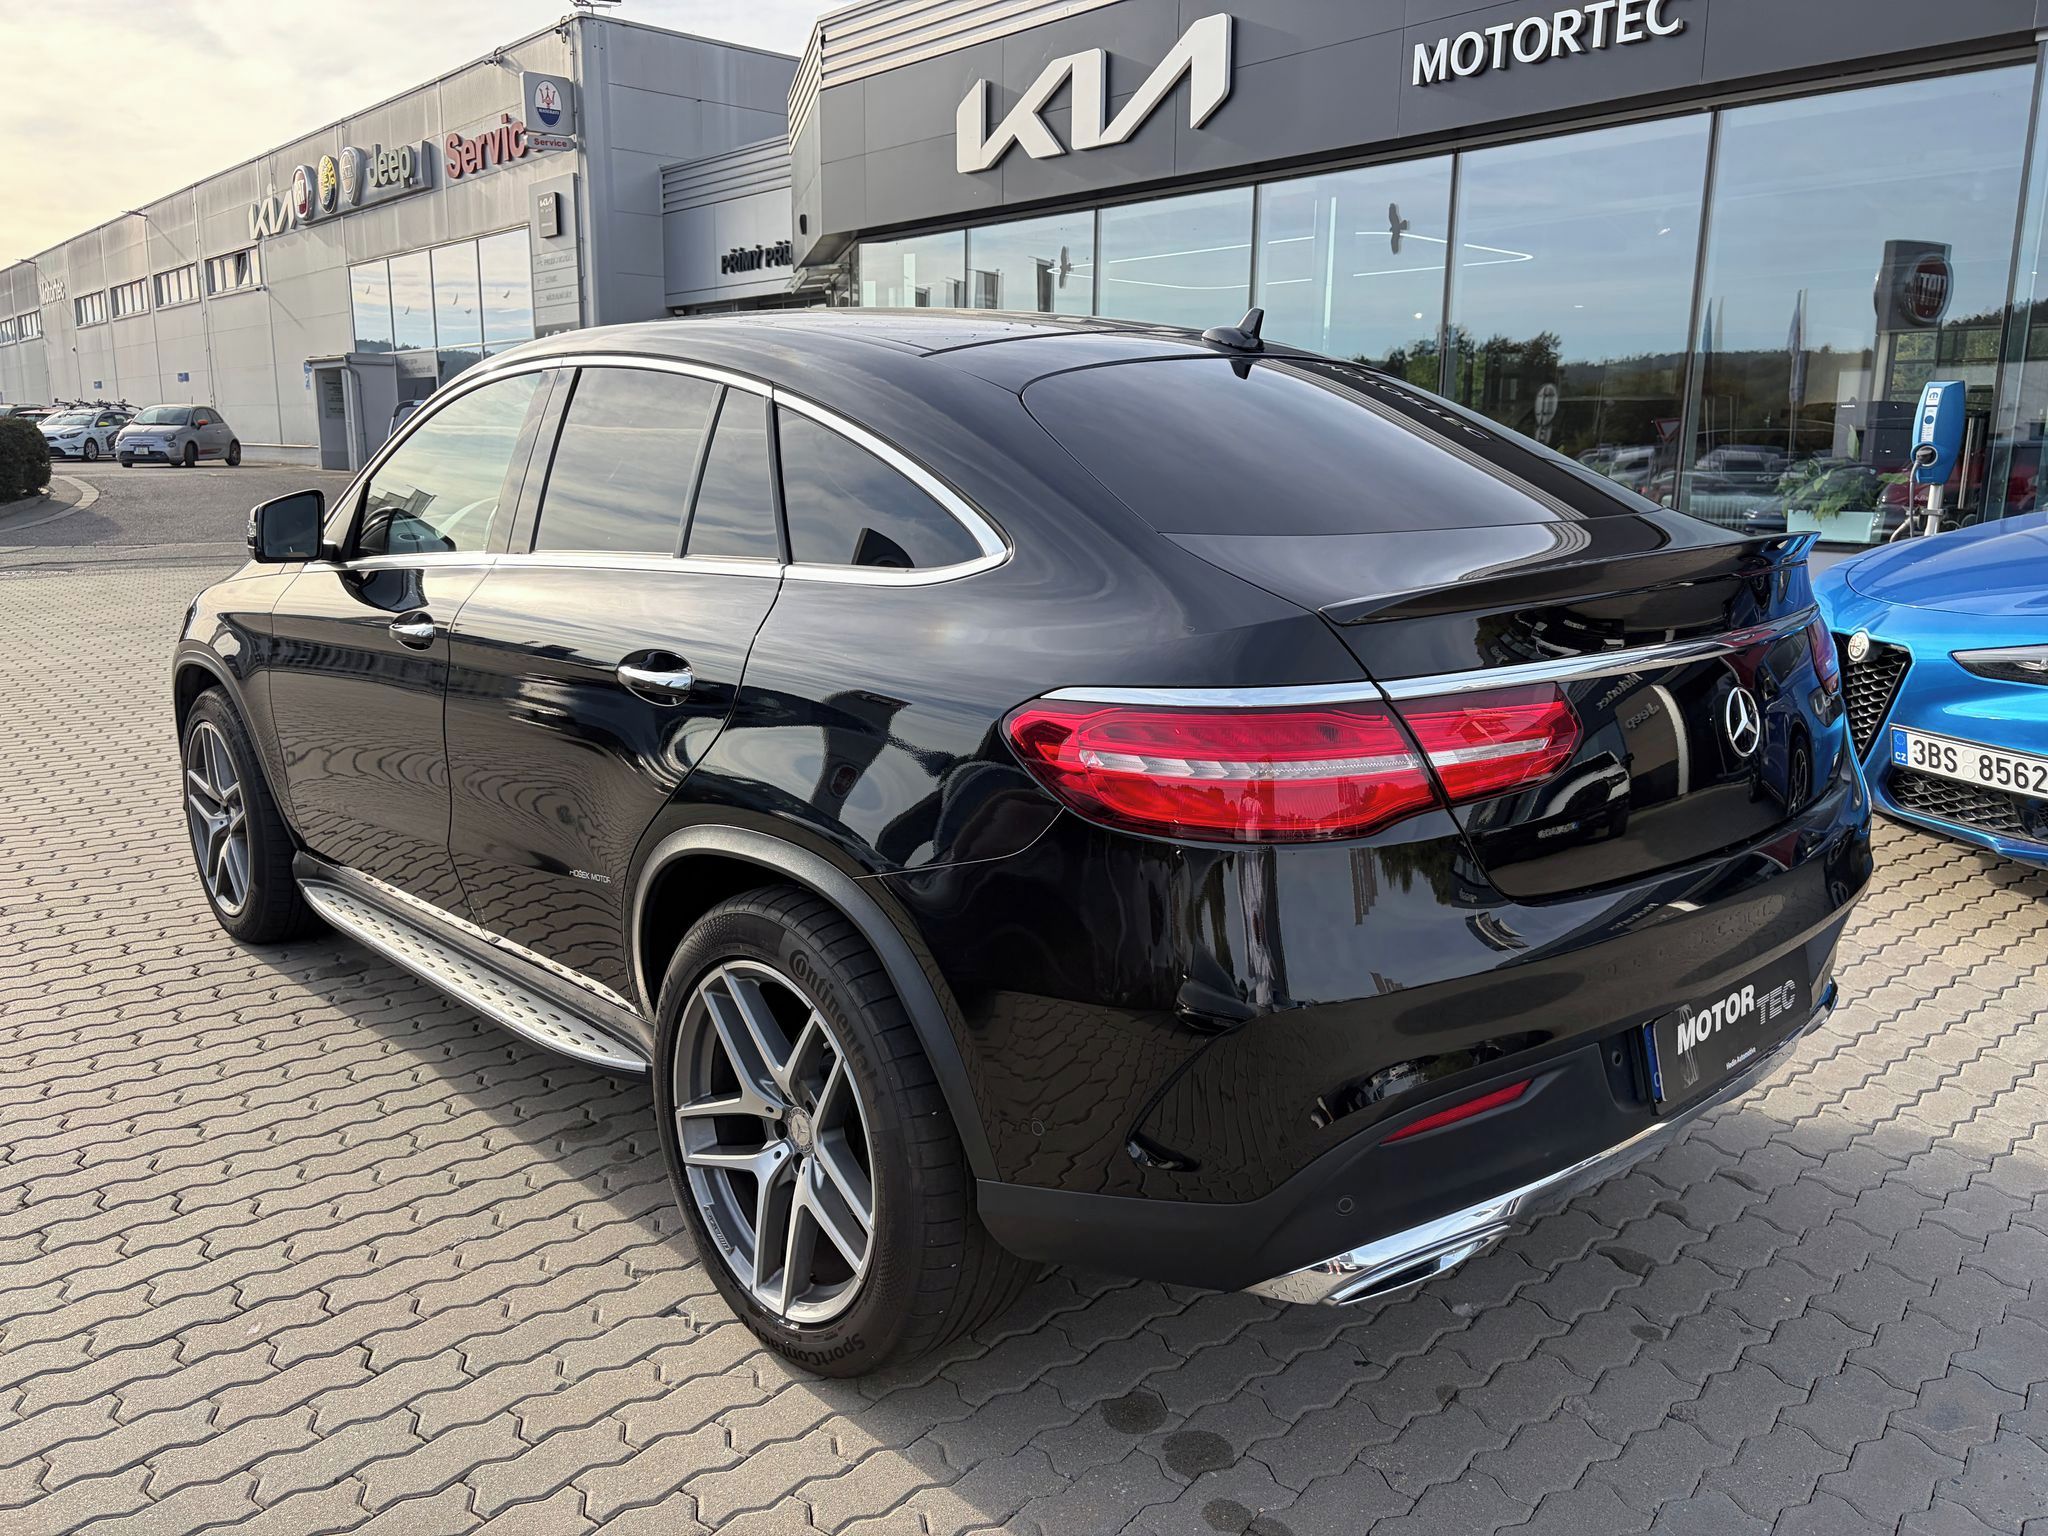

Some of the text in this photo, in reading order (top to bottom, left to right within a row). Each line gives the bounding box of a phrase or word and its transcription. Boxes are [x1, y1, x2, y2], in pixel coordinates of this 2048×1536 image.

[1412, 0, 1685, 87] MOTORTEC
[957, 13, 1232, 173] KIA
[366, 143, 416, 188] Jeep
[446, 113, 526, 178] Servic
[534, 138, 568, 148] Service
[248, 190, 297, 240] KIA
[721, 244, 764, 275] PŘÍMÝ
[1895, 751, 1907, 762] CZ
[1913, 740, 2048, 794] 3BS 8562
[788, 949, 878, 1082] Continental
[1677, 979, 1796, 1055] MOTOR TEC
